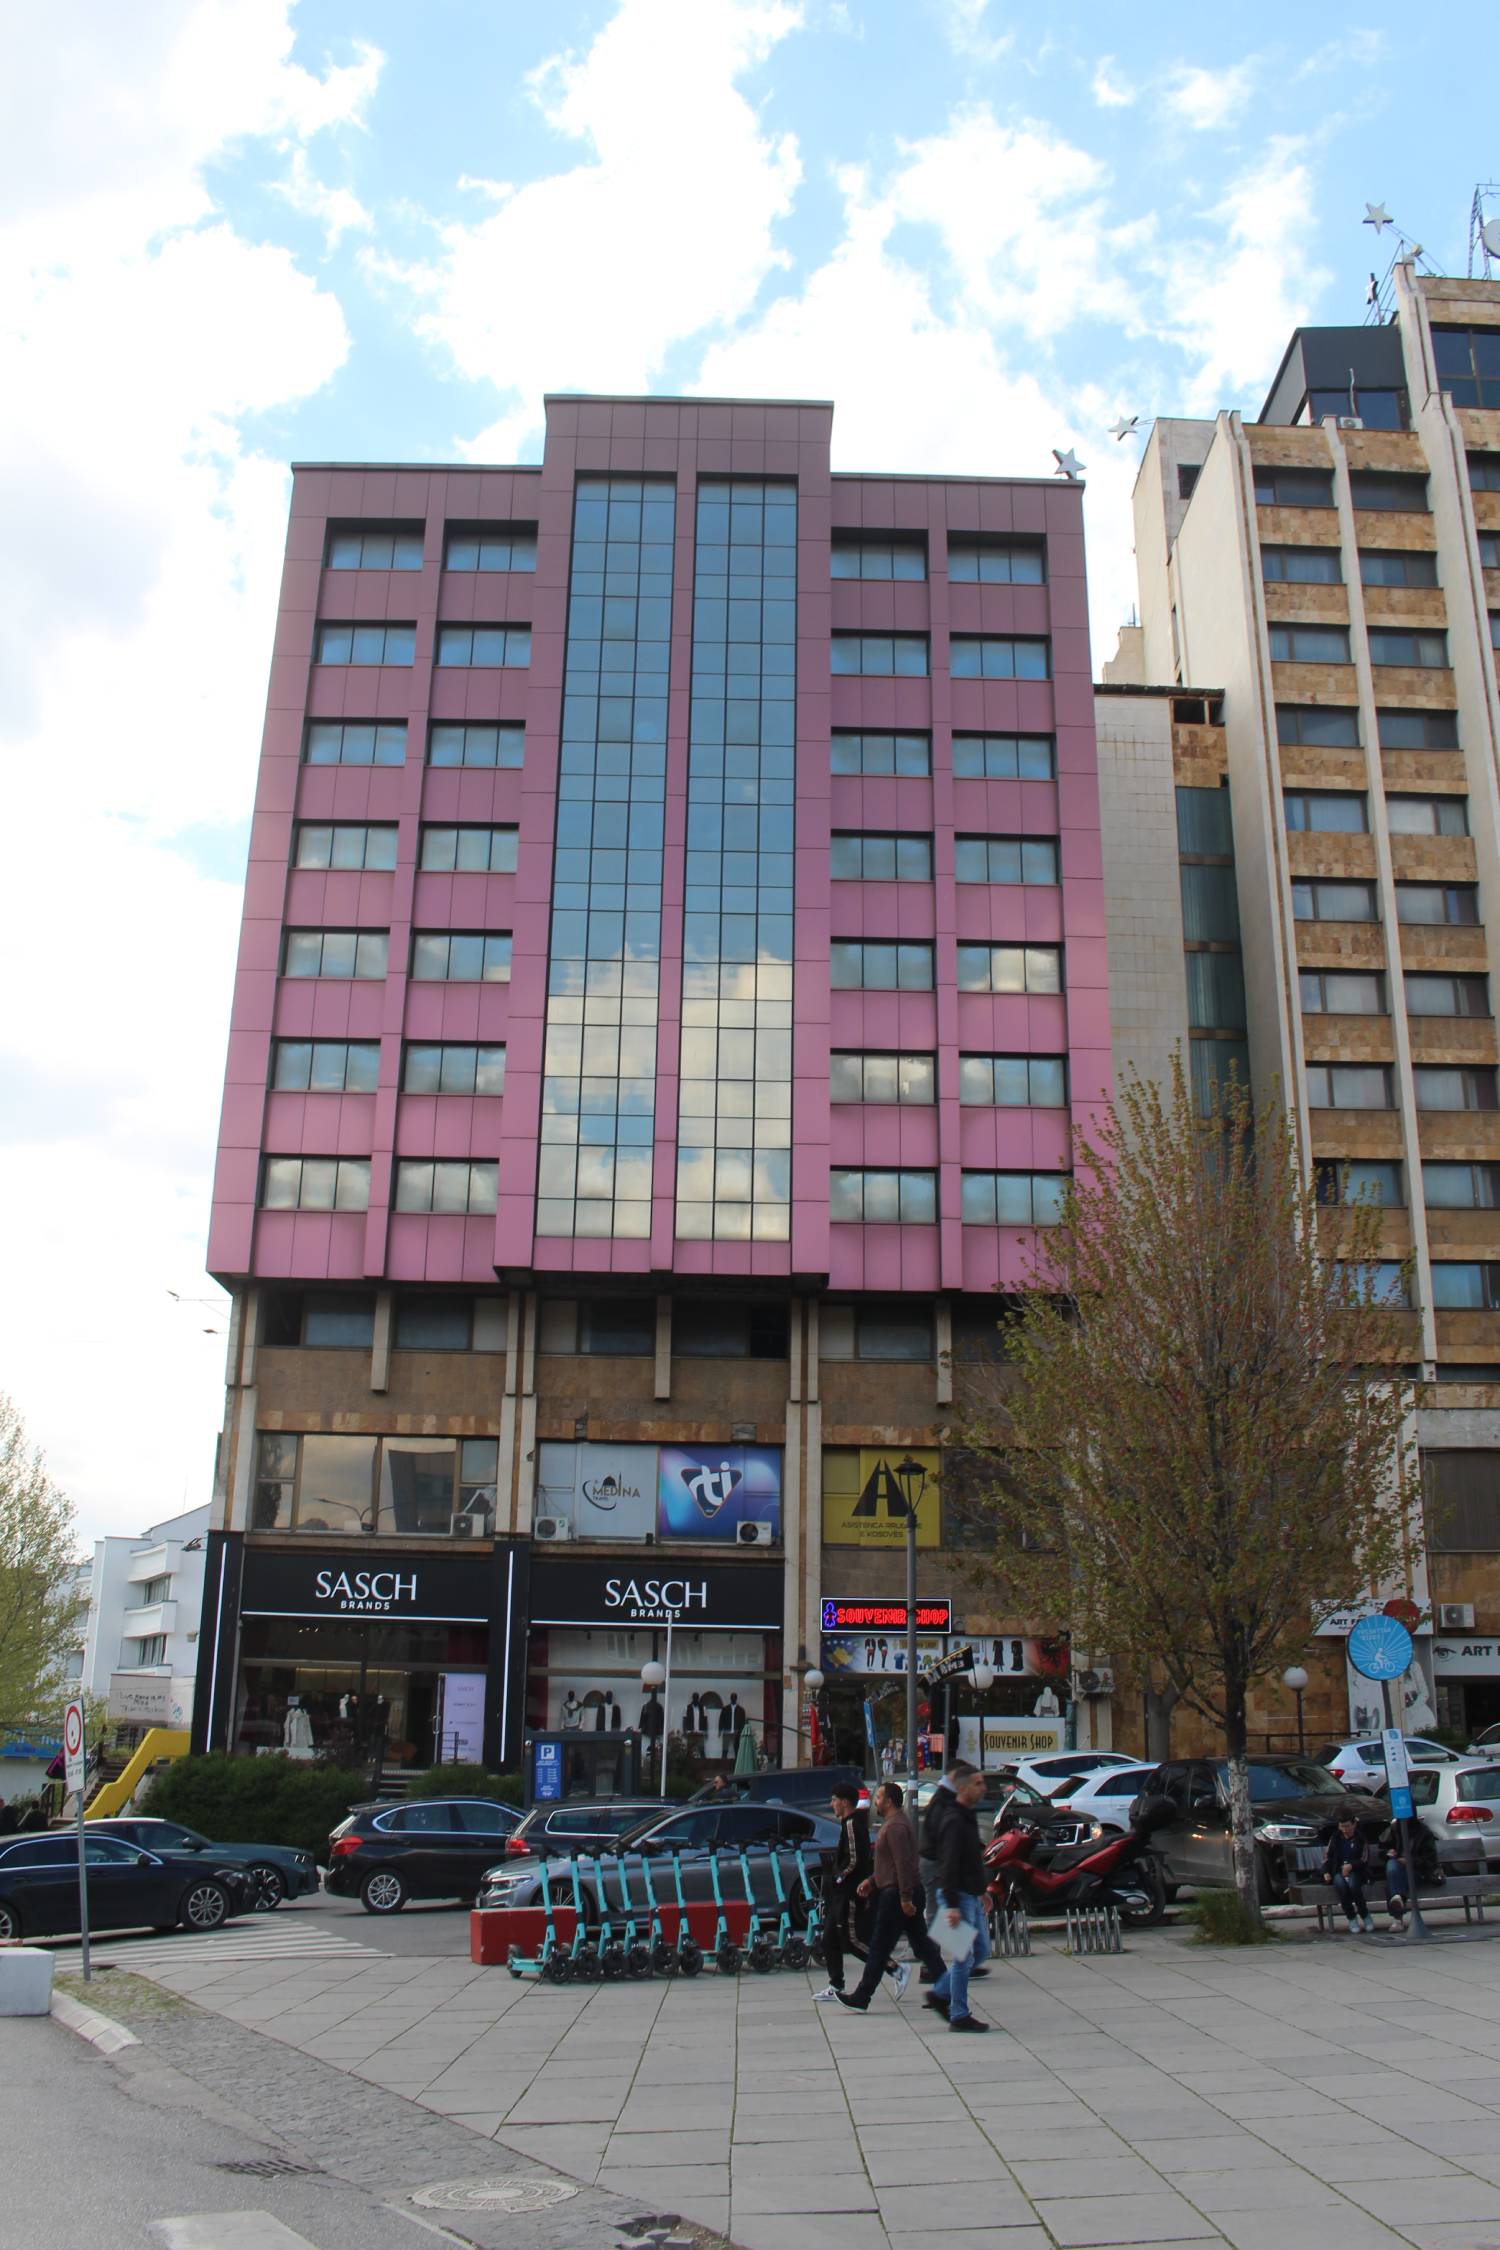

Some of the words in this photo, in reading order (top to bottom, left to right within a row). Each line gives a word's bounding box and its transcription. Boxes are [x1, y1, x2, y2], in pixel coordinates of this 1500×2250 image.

[315, 1571, 417, 1601] SASCH
[604, 1579, 707, 1608] SASCH
[340, 1601, 391, 1611] BRANDS
[630, 1608, 681, 1618] BRANDS
[836, 1607, 907, 1624] SOUVENIR
[1461, 1645, 1493, 1657] ART
[984, 1733, 1028, 1751] SOUVENIR
[1030, 1733, 1054, 1751] SHOP
